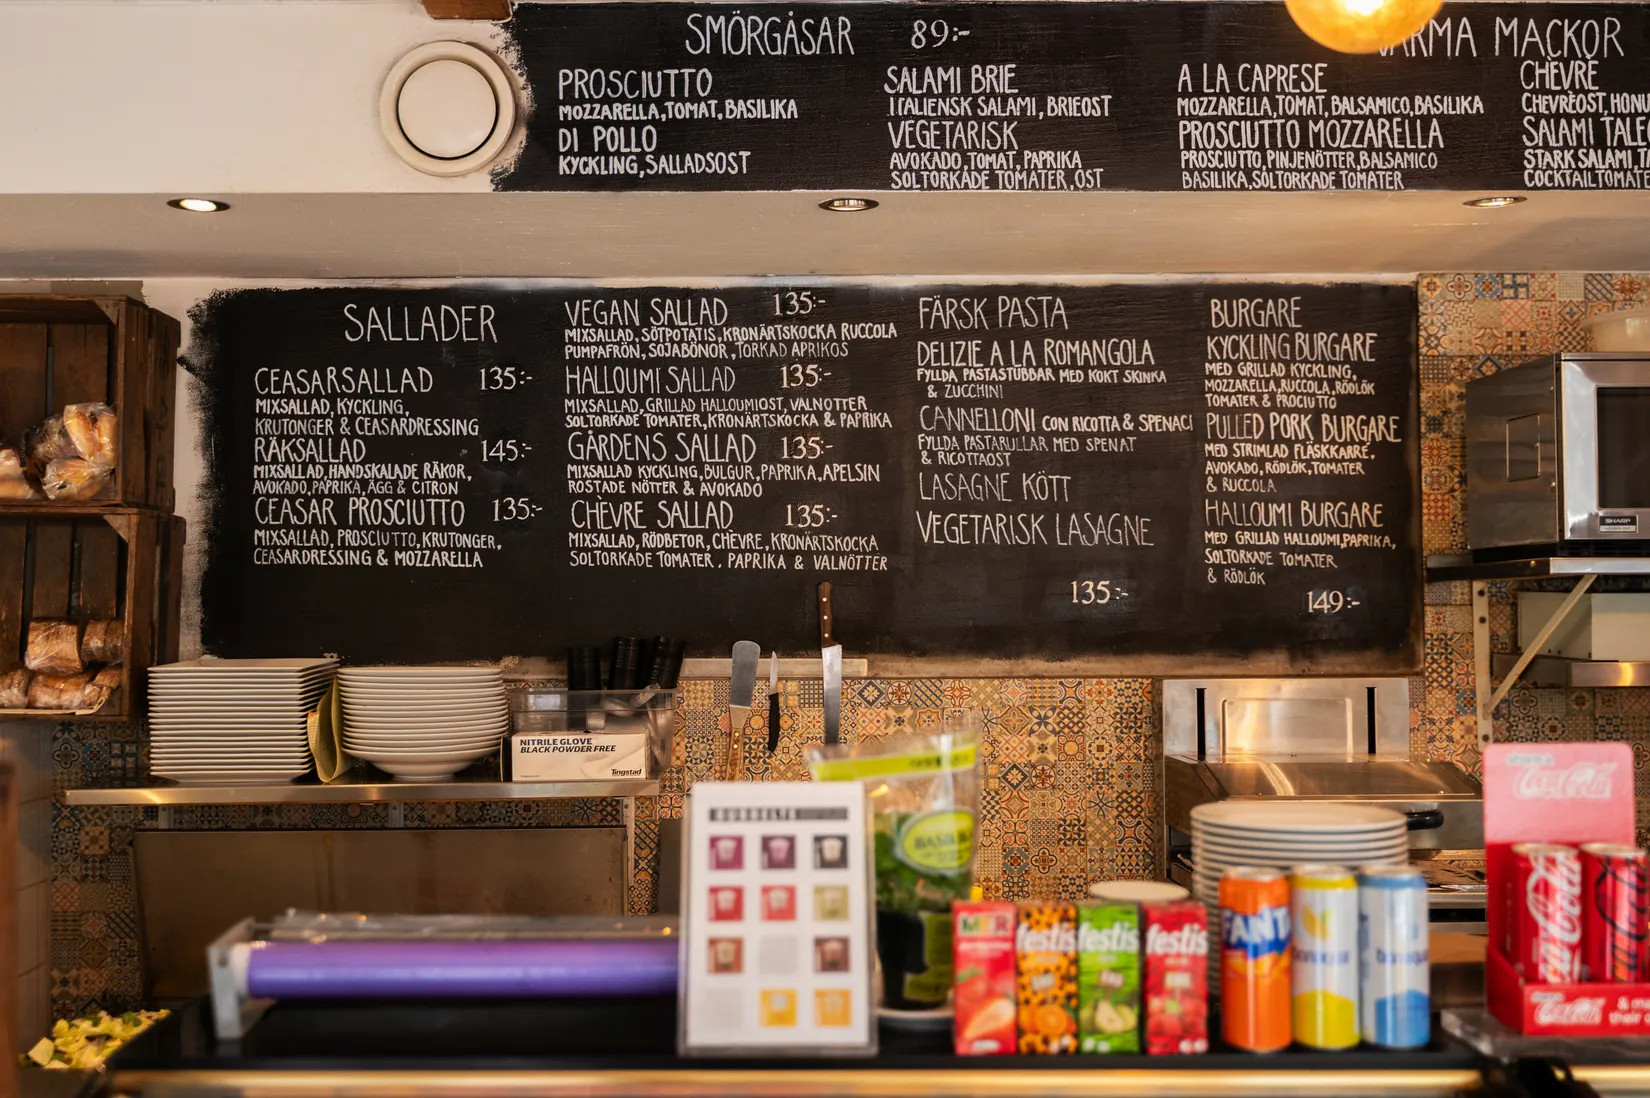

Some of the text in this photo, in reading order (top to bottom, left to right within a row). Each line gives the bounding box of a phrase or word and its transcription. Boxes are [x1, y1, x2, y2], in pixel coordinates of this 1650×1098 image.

[686, 10, 854, 55] SMÖRGÅSAR
[1495, 17, 1624, 58] MACKOR
[559, 68, 712, 100] PROSCIUTTO
[884, 64, 1018, 94] SALAMI BRIE
[1178, 63, 1328, 93] A LA CAPRESE
[889, 96, 972, 116] ITALIENSK
[1048, 95, 1112, 117] BRIEOST
[559, 125, 657, 152] DI POLLO
[888, 119, 1018, 150] VEGETARISK
[1179, 118, 1444, 149] PROSCIUTTO MOZZARELLA
[1522, 116, 1594, 147] SALAMI
[1524, 149, 1576, 168] STARK
[1340, 171, 1404, 190] TOMATER
[565, 291, 826, 327] VEGAN SALLAD 135:-
[919, 296, 1068, 330] FÄRSK PASTA
[1211, 296, 1302, 328] BURGARE
[344, 303, 498, 343] SALLADER
[841, 323, 896, 340] RUCCOLA
[791, 342, 848, 358] APRIKOS
[917, 339, 1155, 367] DELIZIE A LA ROMANGOLA
[1207, 332, 1378, 362] KYCKLING BURGARE
[255, 366, 532, 395] CEASARSALLAD 135:-
[566, 364, 831, 394] HALLOUMI SALLAD 135:-
[917, 369, 1166, 383] FYLLDA MED KOKT SKINKA
[1205, 363, 1232, 376] MED
[1237, 363, 1285, 378] GRILLAD
[945, 384, 1003, 399] ZUCCHINI
[1205, 394, 1337, 409] TOMATER & PROCIUTTO
[255, 418, 334, 436] KRUTONGER
[823, 413, 836, 427] &
[840, 413, 892, 428] PAPRIKA
[920, 406, 1194, 433] CANNELLONI CON RICOTTA & SPENACI
[1206, 412, 1402, 442] PULLED PORK BURGARE
[254, 437, 531, 462] RÄKSALLAD 145:-
[567, 430, 833, 463] GÅRDENS SALLAD 135:-
[918, 434, 1136, 452] FYLLDA PASTARULLAR MED SPENAT
[1205, 443, 1288, 458] MED STRIMLAD
[423, 461, 472, 481] RÄKOR,
[938, 452, 1011, 467] RICOTTAOST
[567, 465, 632, 479] MIXSALLAD
[412, 481, 459, 495] CITRON
[568, 480, 763, 497] ROSTADE NÖTTER & AVOKADO
[919, 471, 1072, 502] LASAGNE KÖTT
[1206, 476, 1277, 492] & RUCCOLA
[255, 496, 542, 527] CEASAR PROSCIUTTO 135:-
[657, 501, 733, 529] SALLAD
[786, 504, 837, 527] 135:-
[1206, 499, 1383, 528] HALLOUMI BURGARE
[254, 529, 334, 548] MIXSALLAD,
[916, 511, 1154, 546] VEGETARISK LASAGNE
[1205, 531, 1279, 545] MED GRILLAD
[770, 532, 878, 552] KRONÄRTSKOCKA
[254, 550, 483, 568] CEASARDRESSING & MOZZARELLA
[570, 551, 652, 568] SOLTORKADE
[728, 553, 786, 570] PAPRIKA
[794, 554, 804, 570] &
[1205, 548, 1338, 568] SOLTORKADE TOMATER
[1208, 567, 1265, 584] & RÖDLÖK
[1070, 580, 1129, 604] 135:-
[1307, 590, 1360, 613] 149:-
